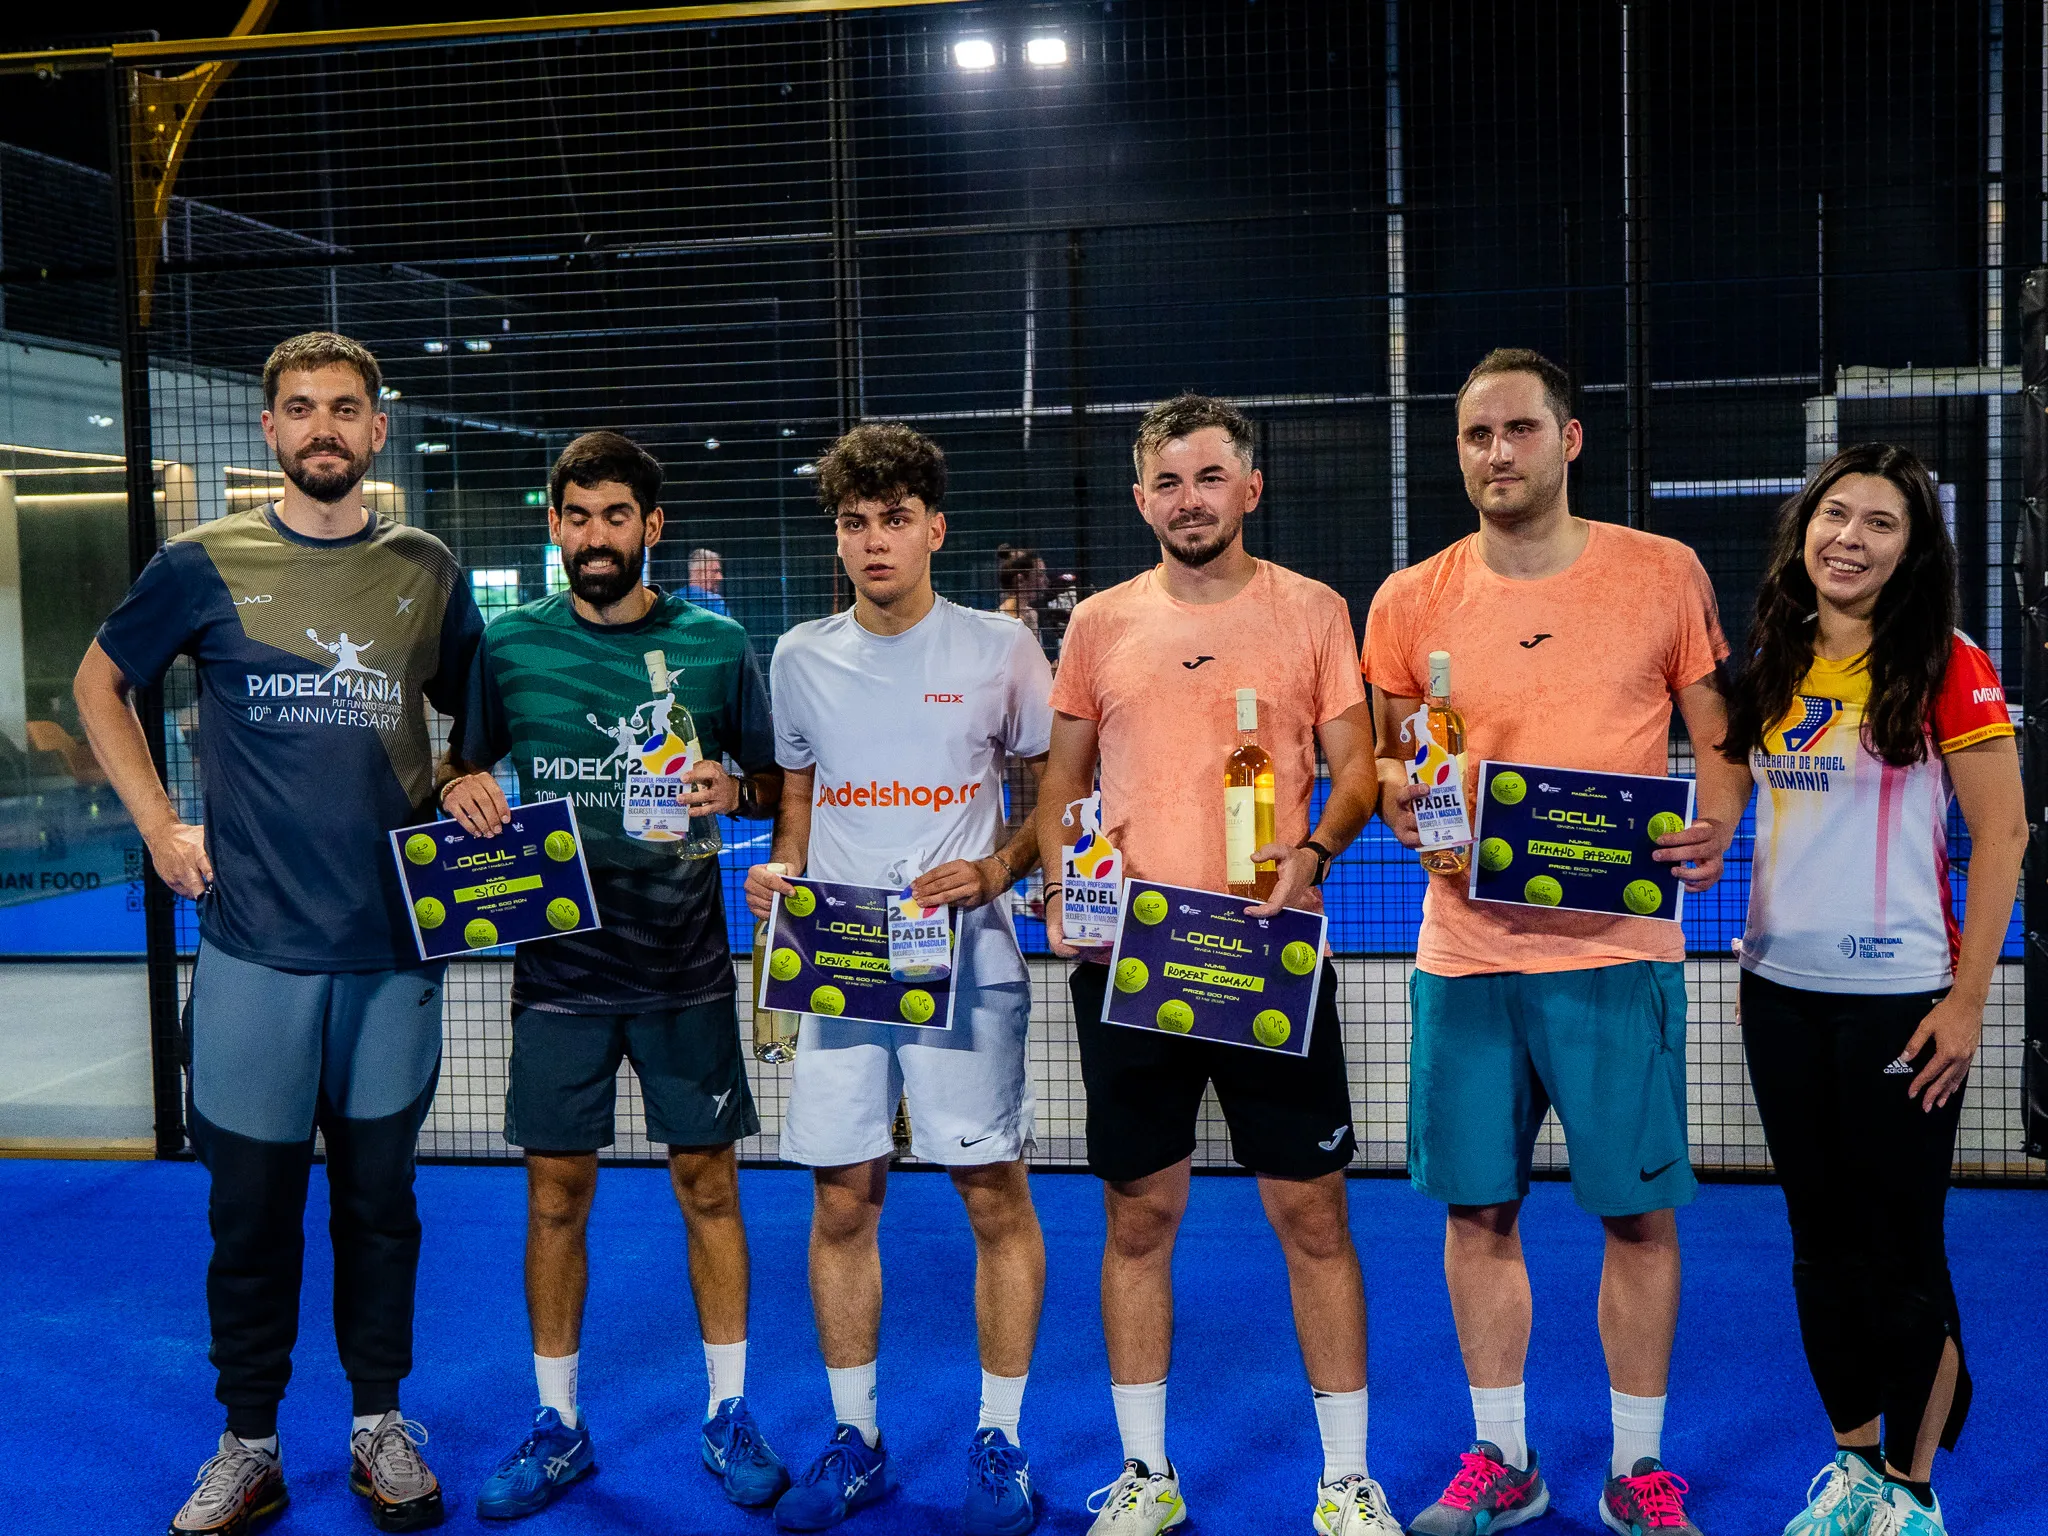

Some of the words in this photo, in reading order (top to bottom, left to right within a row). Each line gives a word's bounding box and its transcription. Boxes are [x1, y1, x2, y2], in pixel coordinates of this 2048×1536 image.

[246, 674, 331, 697] PADEL
[334, 676, 402, 704] MANIA
[332, 698, 346, 708] PUT
[347, 700, 361, 709] FUN
[362, 701, 377, 710] INTO
[378, 703, 402, 714] SPORTS
[247, 705, 271, 722] 10th
[278, 706, 401, 731] ANNIVERSARY
[534, 757, 612, 780] PADEL
[628, 759, 647, 775] 2.
[1799, 756, 1811, 769] DE
[1814, 756, 1845, 771] PADEL
[1767, 770, 1829, 792] ROMANIA
[567, 792, 626, 807] ANNIVE
[629, 799, 650, 807] DIVIZIA
[1415, 794, 1460, 811] PADEL
[1532, 807, 1617, 828] LOCUL
[1628, 818, 1635, 829] 1
[442, 849, 516, 871] LOCUL
[522, 844, 538, 856] 2
[1066, 860, 1081, 878] 1.
[0, 872, 33, 889] AN
[41, 872, 100, 889] FOOD
[1065, 888, 1117, 905] PADEL
[889, 906, 907, 921] 2.
[1065, 903, 1085, 912] DIVIZIA
[1090, 905, 1118, 915] MASCULIN
[815, 919, 889, 938] LOCUL
[892, 926, 946, 941] PADEL
[892, 941, 912, 950] DIVIZIA
[918, 939, 946, 947] MASCULIN
[1170, 929, 1253, 953] LOCUL
[1263, 944, 1270, 956] 1
[1167, 965, 1209, 981] ROBERT
